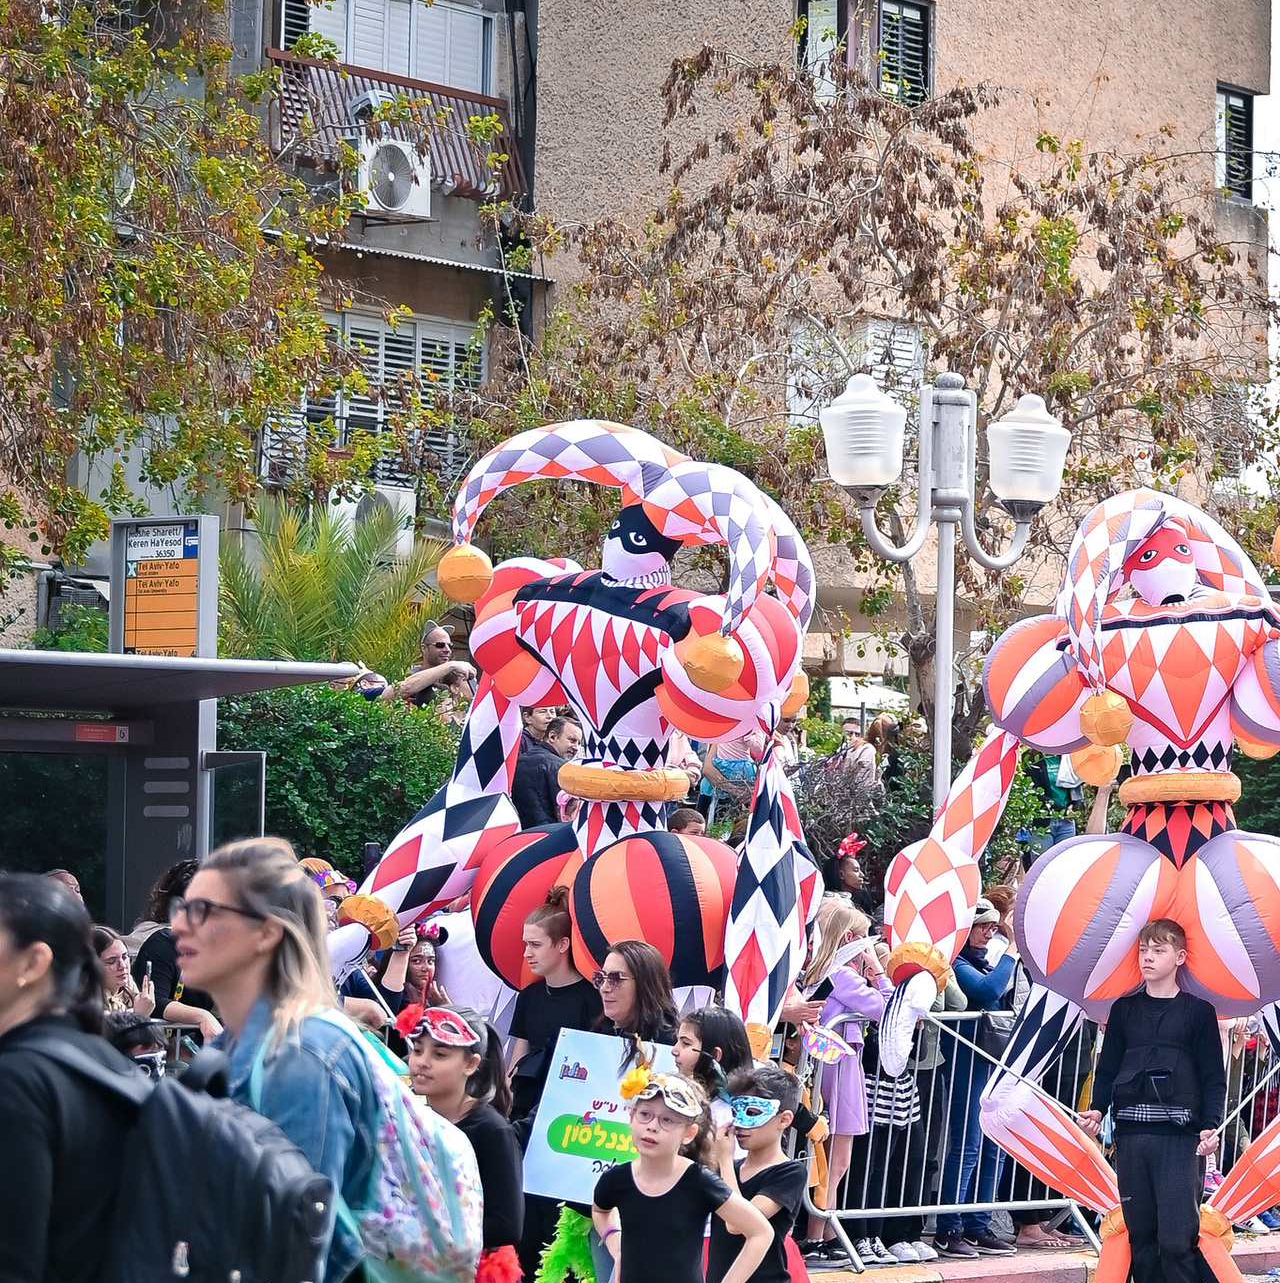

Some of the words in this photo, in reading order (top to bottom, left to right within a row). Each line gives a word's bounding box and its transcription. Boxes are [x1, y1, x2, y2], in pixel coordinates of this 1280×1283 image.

[128, 539, 149, 548] Keren
[150, 538, 182, 548] HaYesod
[155, 549, 176, 558] 36350
[138, 580, 148, 589] Tel
